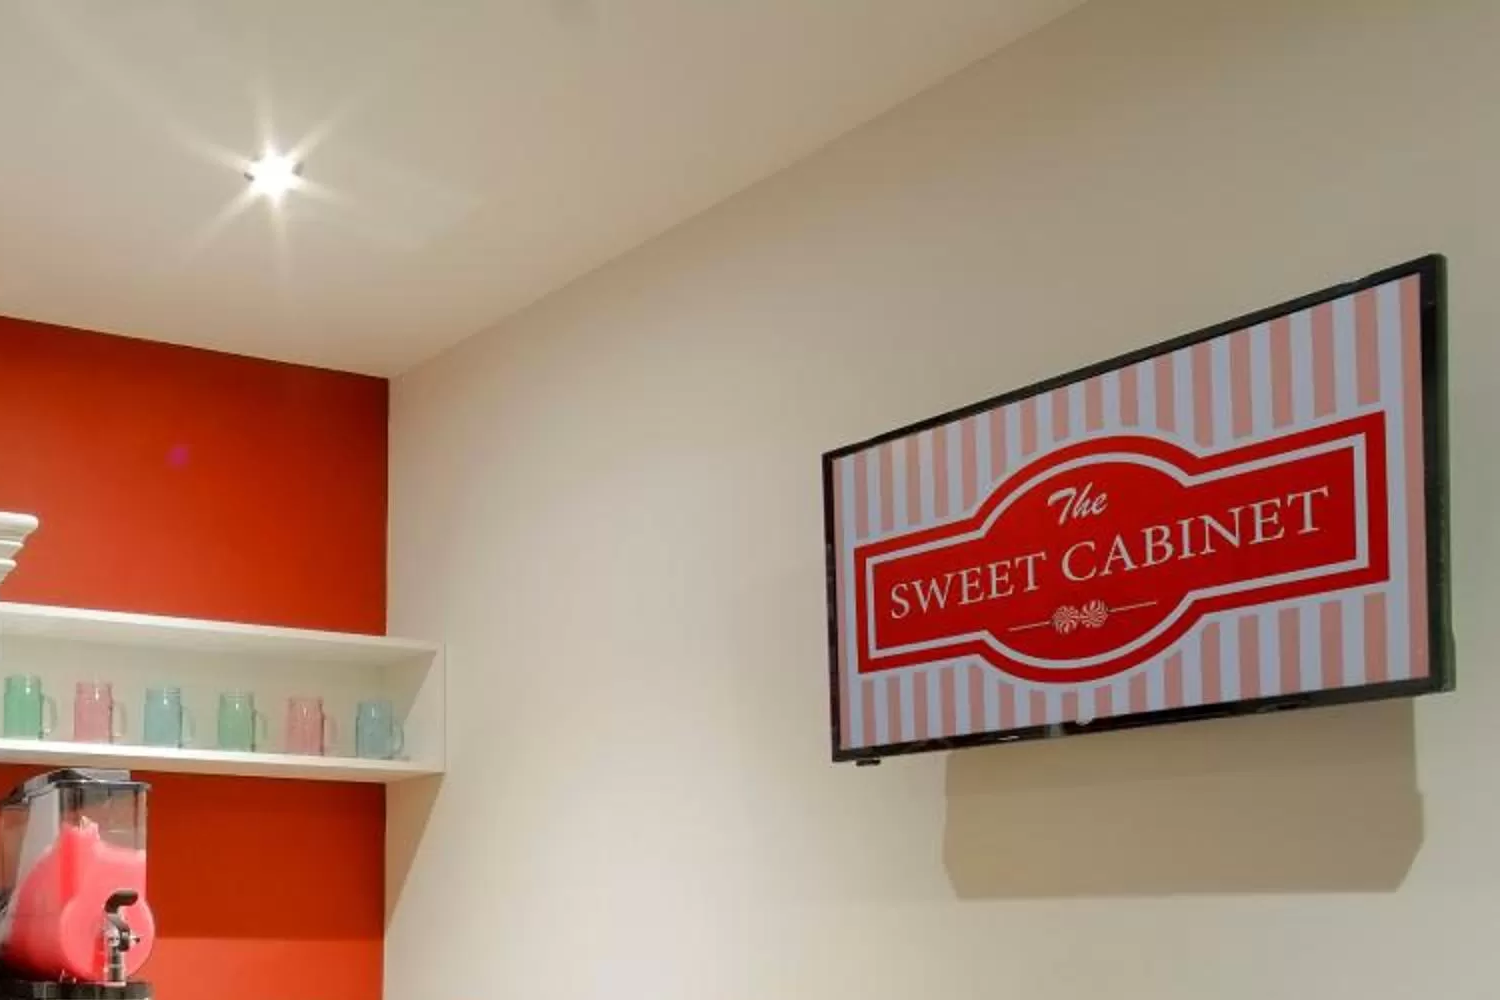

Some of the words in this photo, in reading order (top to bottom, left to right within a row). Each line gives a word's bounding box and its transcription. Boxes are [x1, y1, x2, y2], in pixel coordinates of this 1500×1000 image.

[1047, 481, 1109, 526] The
[890, 551, 1047, 620] SWEET
[1060, 486, 1330, 582] CABINET
